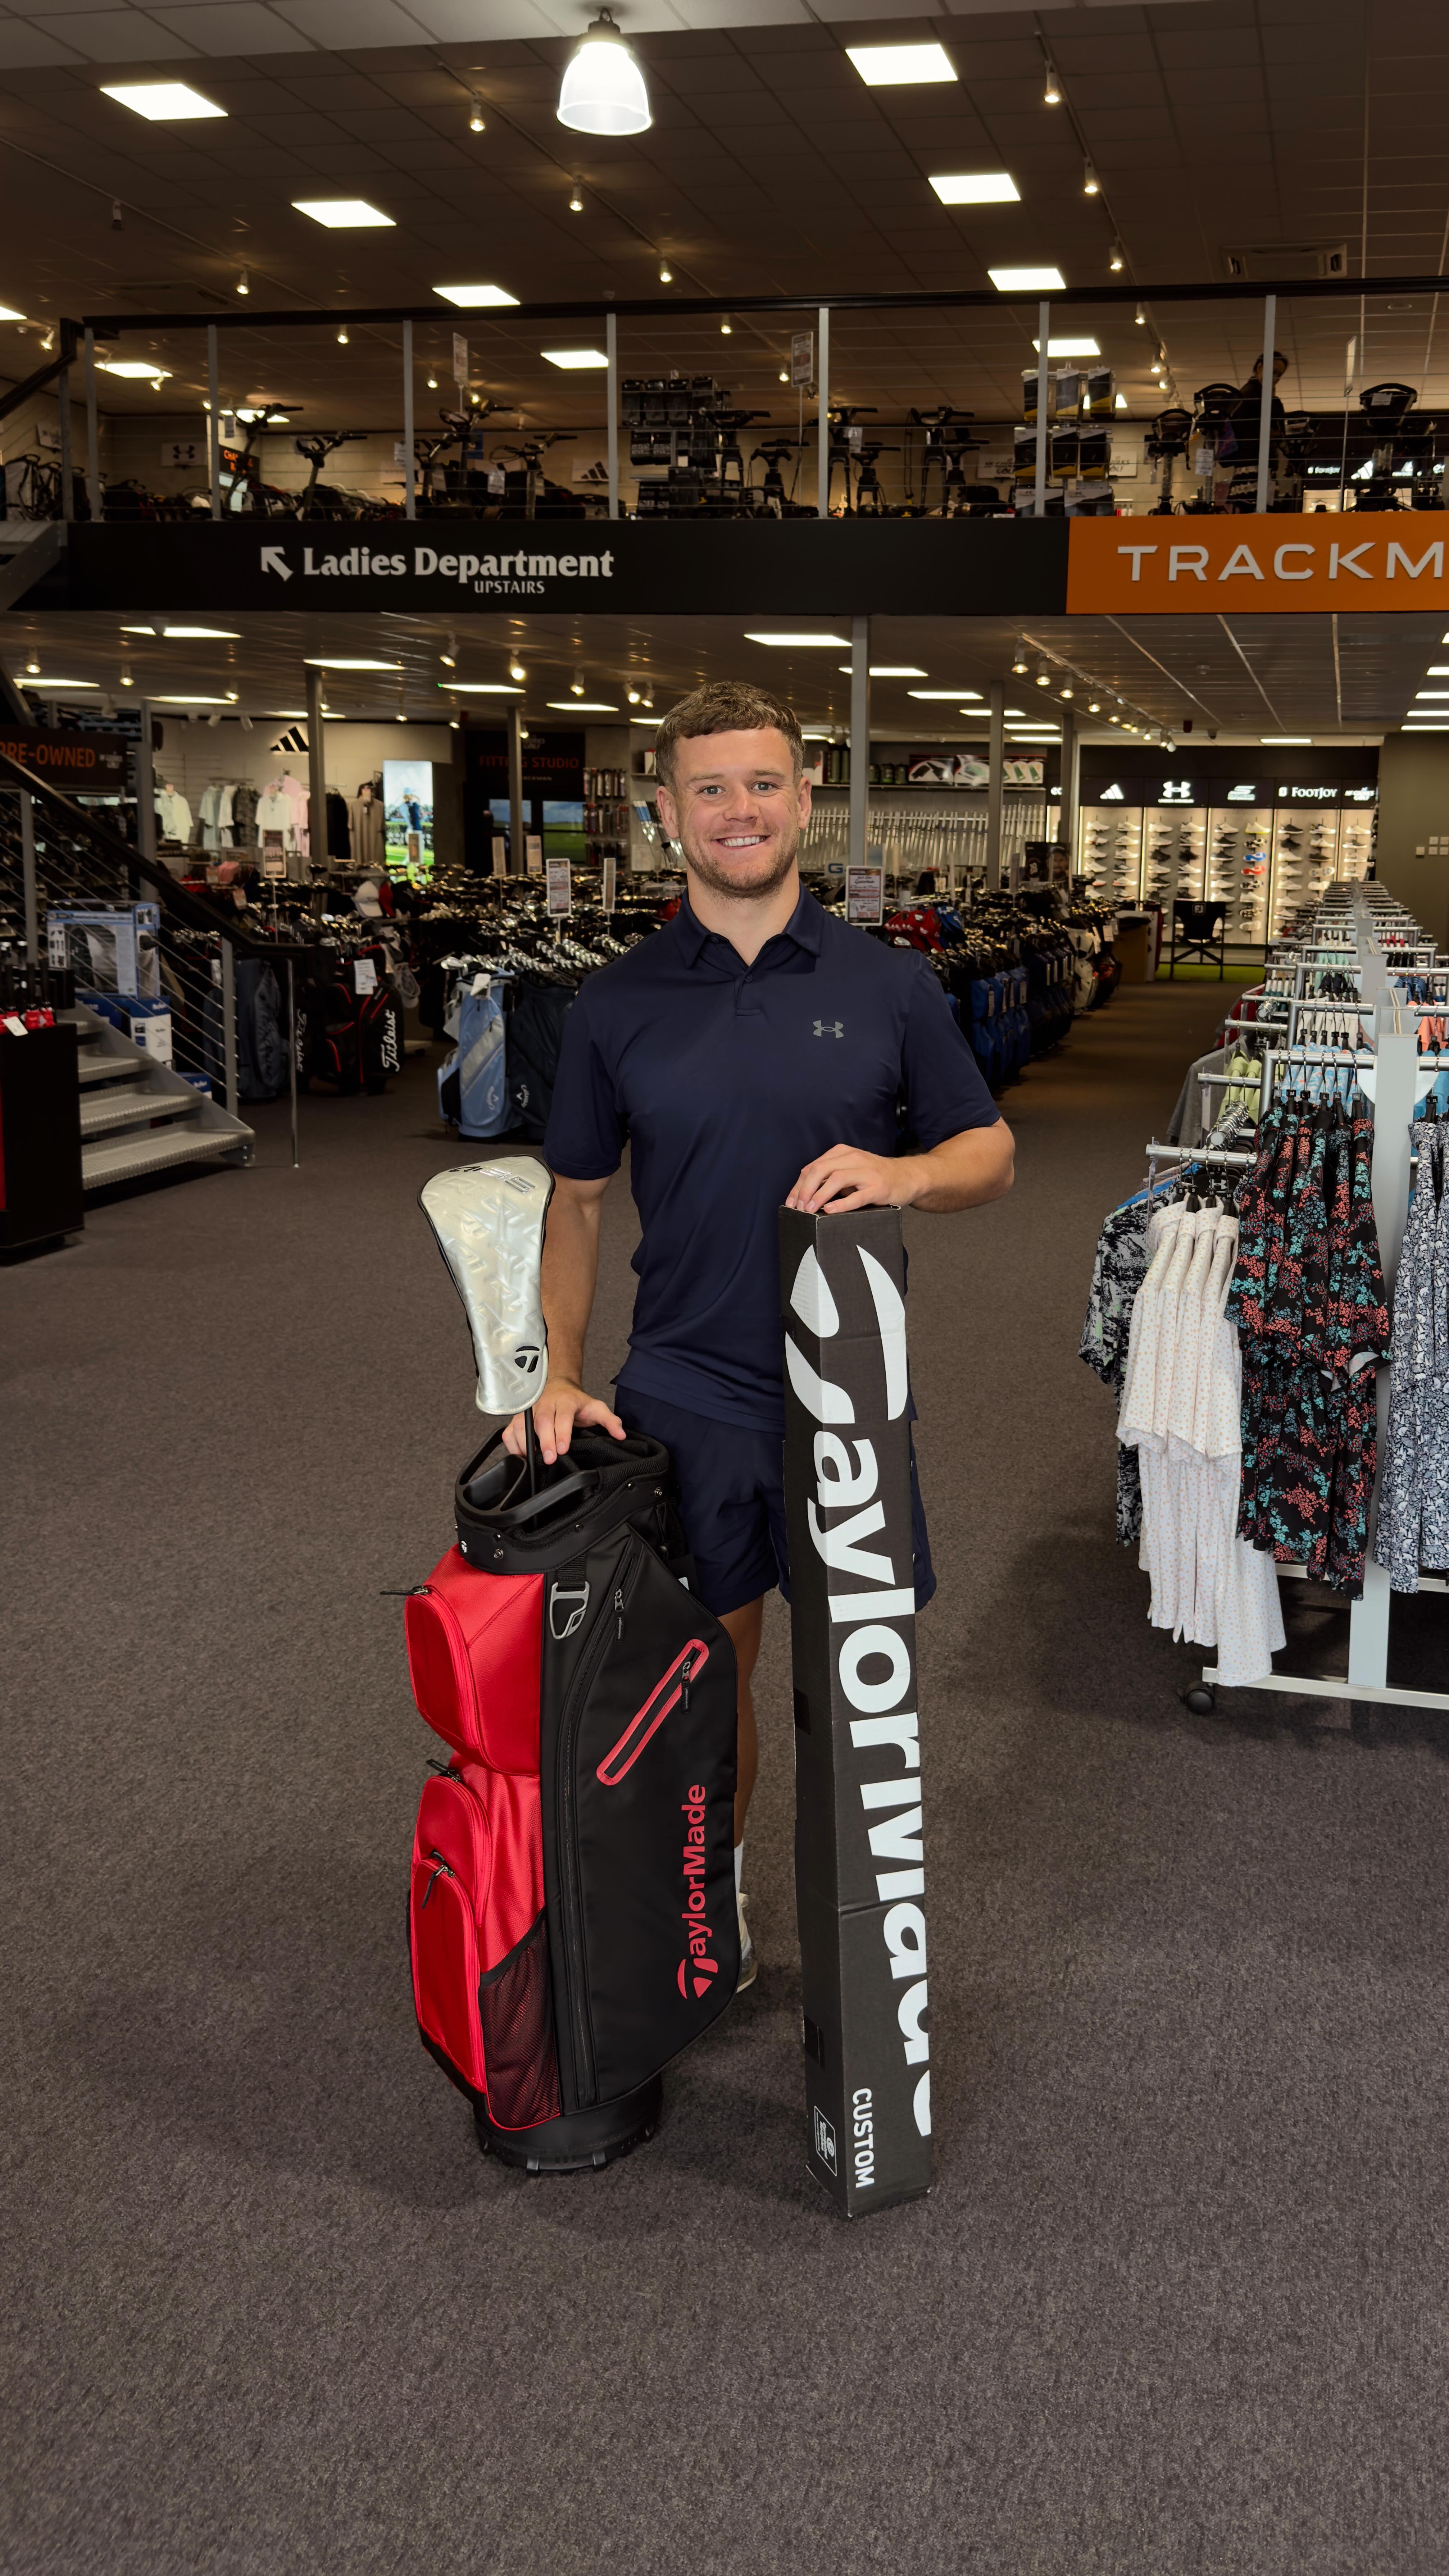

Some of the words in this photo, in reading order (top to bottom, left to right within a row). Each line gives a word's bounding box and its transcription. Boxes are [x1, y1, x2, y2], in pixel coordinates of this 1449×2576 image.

[303, 547, 406, 575] Ladies
[414, 547, 614, 583] Department
[1117, 542, 1444, 581] TRACKM
[474, 581, 545, 594] UPSTAIRS
[478, 755, 527, 768] FITTIG
[531, 756, 579, 769] STUDIO
[380, 1008, 400, 1072] Titleist
[785, 1244, 932, 2136] TaylorMa
[677, 1784, 718, 1999] TaylorMade
[852, 2088, 875, 2189] CUSTOM
